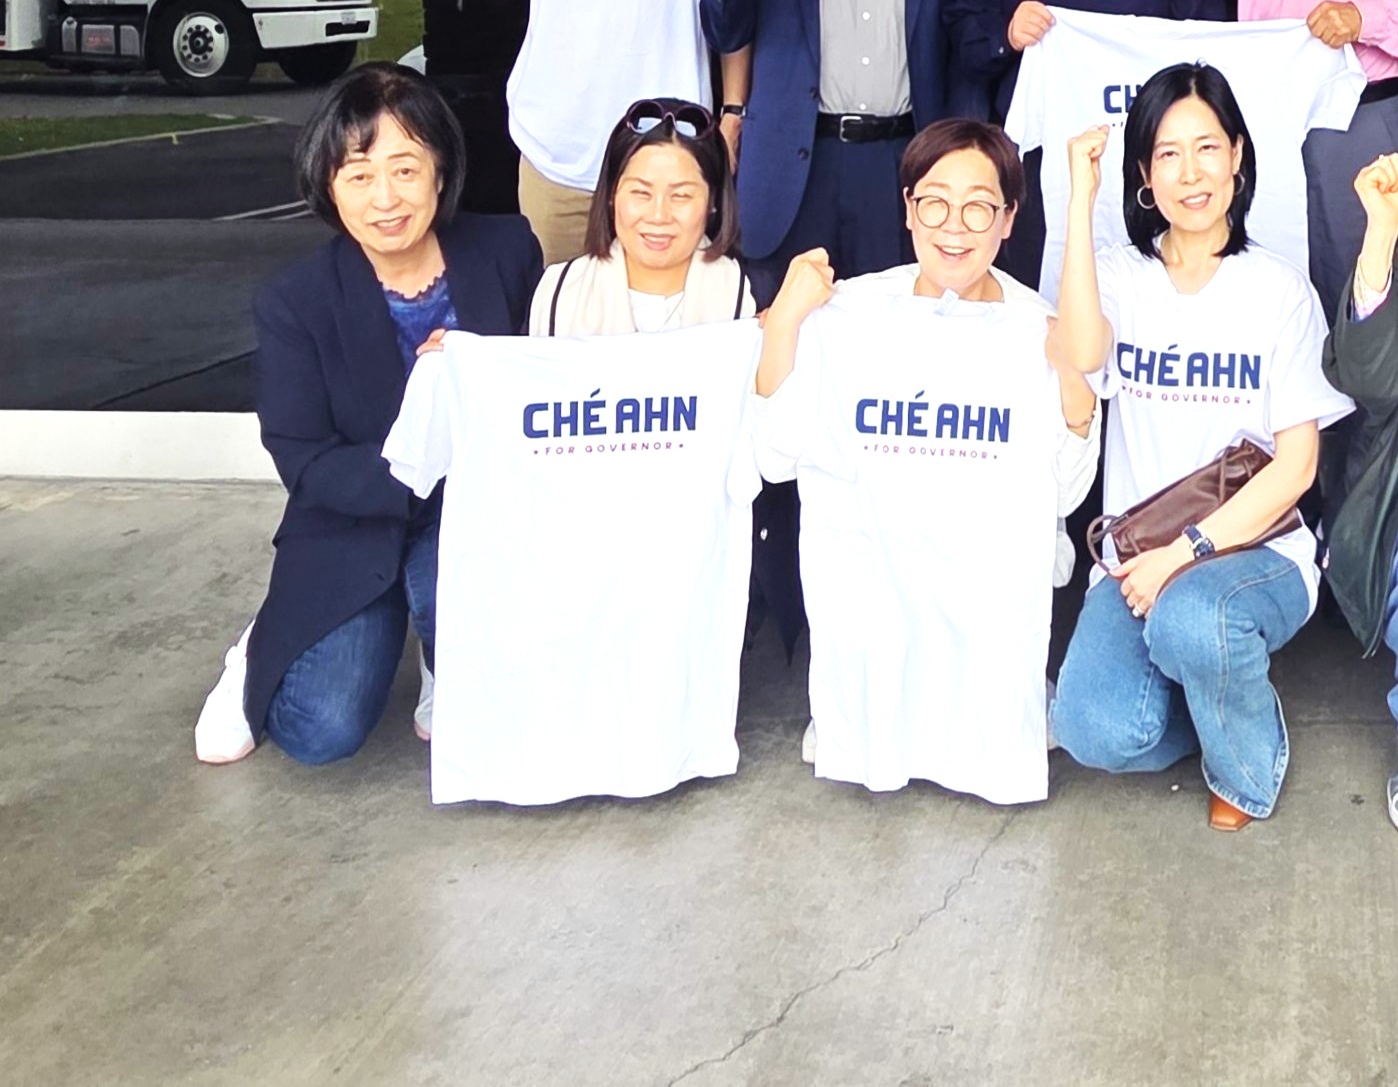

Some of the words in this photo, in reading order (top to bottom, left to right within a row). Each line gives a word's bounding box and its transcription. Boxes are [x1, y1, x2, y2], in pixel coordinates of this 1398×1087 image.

[1103, 84, 1142, 114] CH
[1117, 342, 1181, 387] CHÉ
[1186, 352, 1261, 390] AHN
[522, 387, 607, 438] CHÉ
[615, 396, 698, 434] AHN
[1161, 393, 1240, 404] GOVERNOR
[855, 389, 929, 437] CHÉ
[935, 403, 1011, 443] AHN
[545, 446, 575, 456] FOR
[585, 442, 672, 453] GOVERNOR
[874, 444, 899, 454] FOR
[909, 446, 987, 459] GOVERNOR
